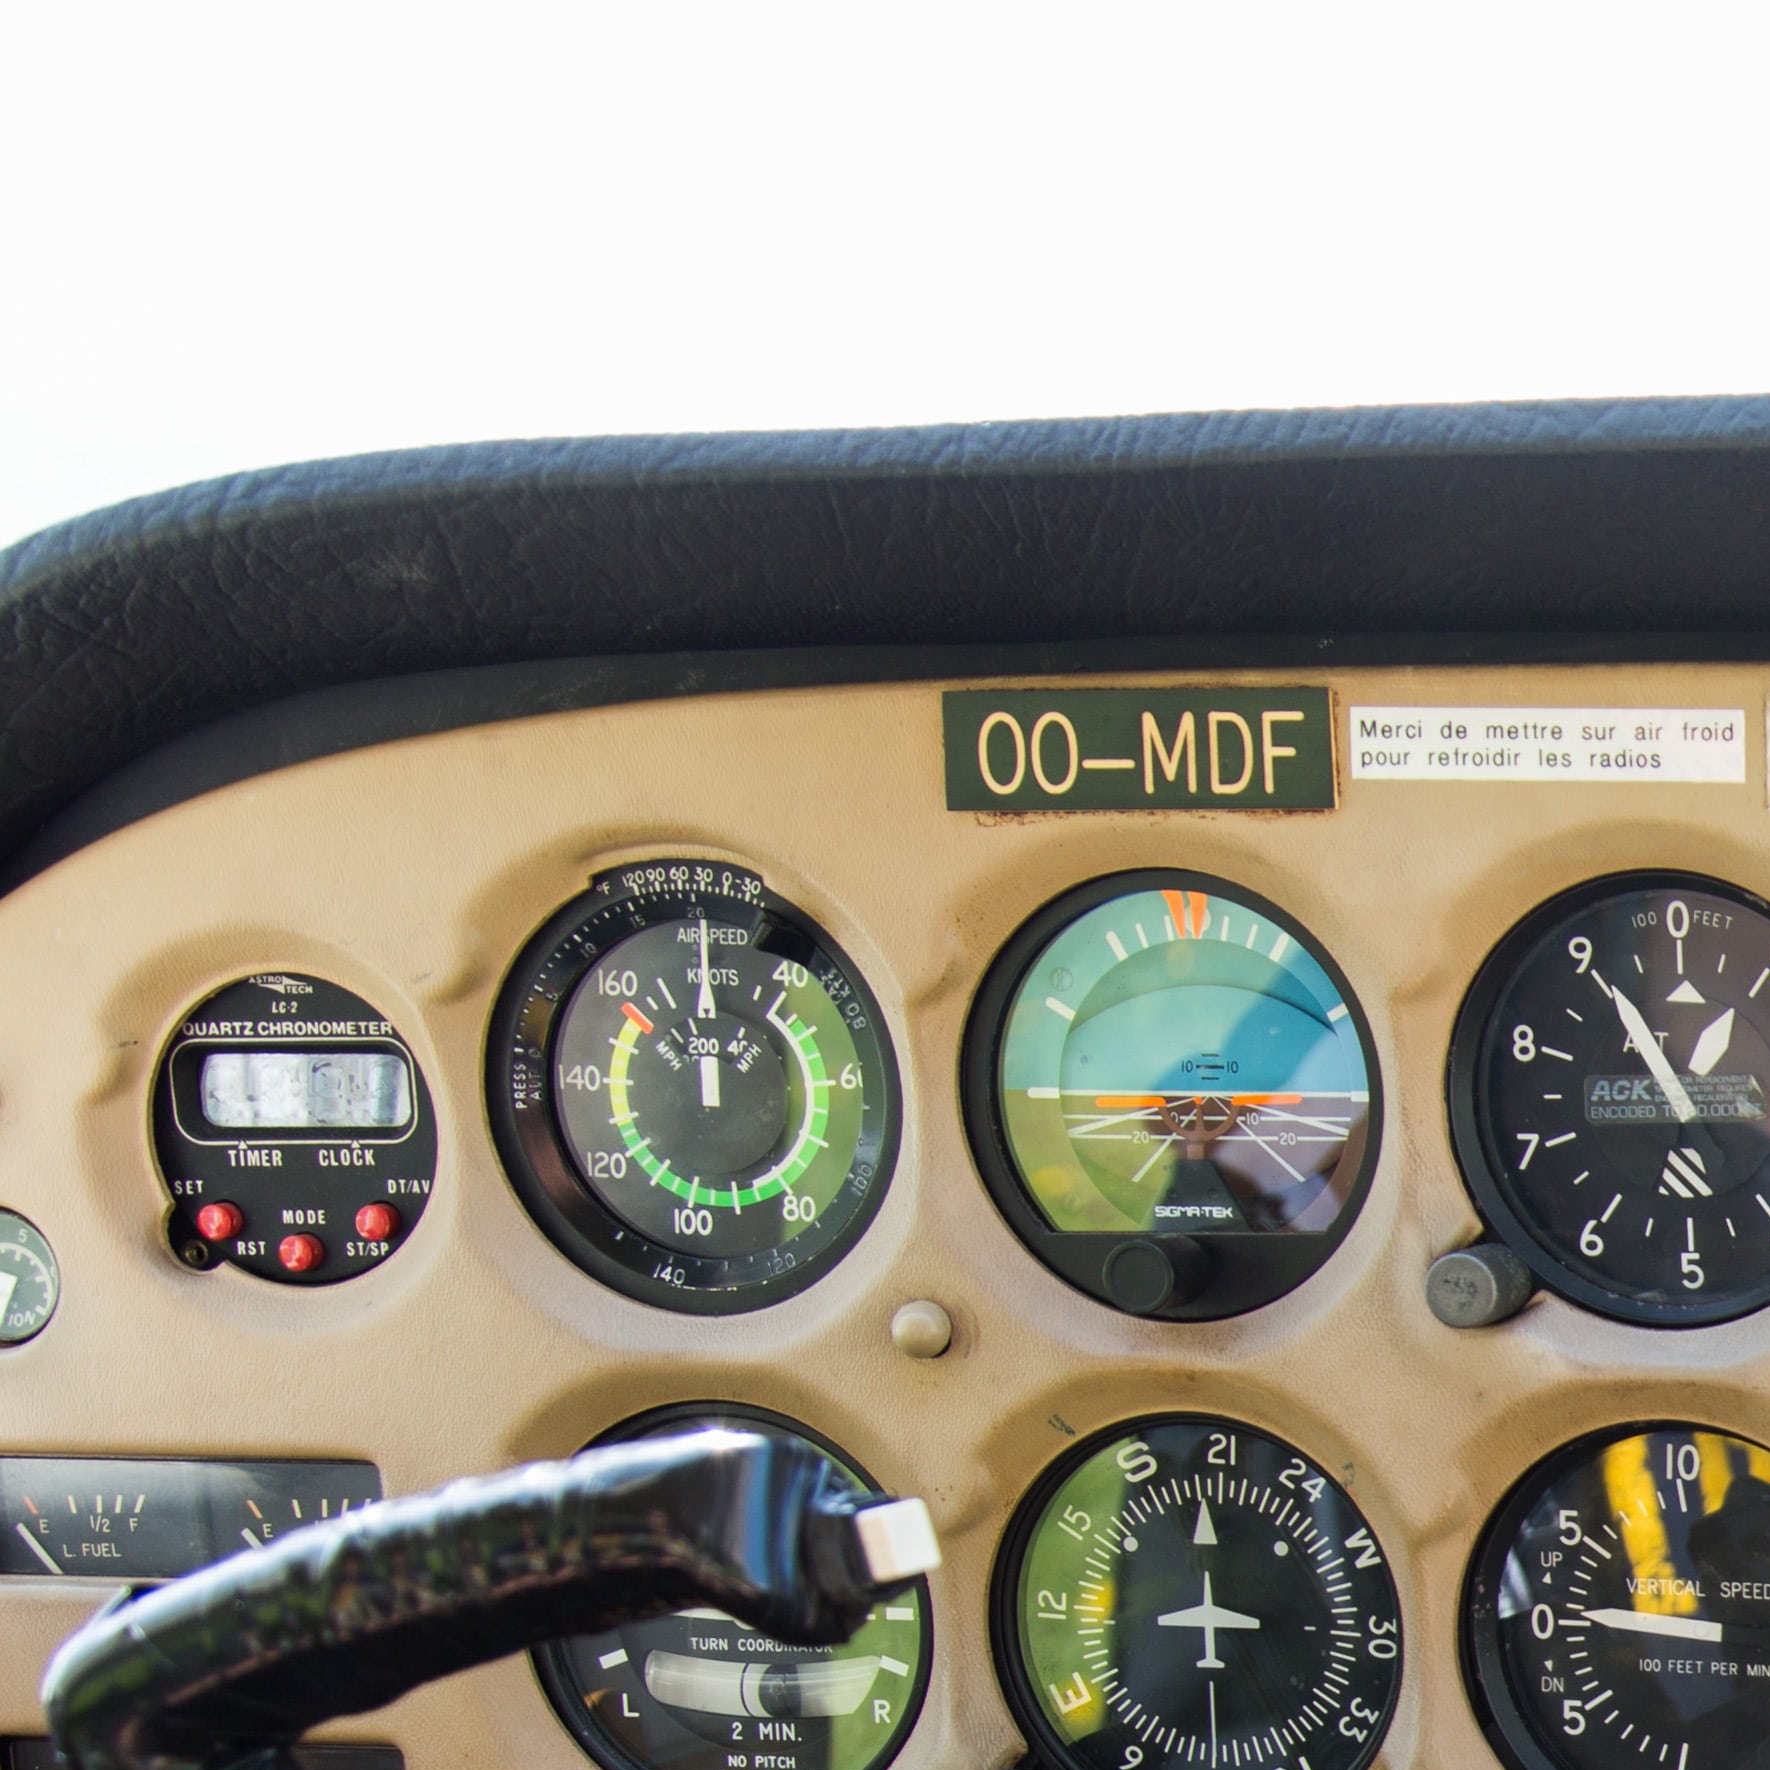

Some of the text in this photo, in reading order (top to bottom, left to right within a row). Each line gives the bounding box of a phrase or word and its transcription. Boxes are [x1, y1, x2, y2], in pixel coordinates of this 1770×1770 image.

[1360, 721, 1735, 742] Merci de mettre sur air froid
[1360, 747, 1661, 770] pour refroidir les radios
[687, 968, 739, 986] KNOTS
[183, 1022, 392, 1035] QUARTZ CHRONOMETER
[559, 1065, 600, 1090] 140
[228, 1150, 282, 1166] TIMER
[320, 1150, 375, 1166] CLOCK
[587, 1153, 626, 1179] 120
[175, 1181, 203, 1194] SET
[388, 1180, 430, 1193] DT/AV
[283, 1211, 326, 1224] MODE
[673, 1209, 712, 1235] 100
[237, 1242, 266, 1255] RST
[347, 1242, 389, 1256] ST/SP
[83, 1544, 121, 1557] FUEL
[1626, 1578, 1706, 1598] VERTICAL
[691, 1637, 728, 1651] TURN
[1639, 1659, 1770, 1677] 100 FEET PER MIN
[732, 1722, 802, 1741] 2 MIN.
[728, 1755, 795, 1769] NO PITCH
